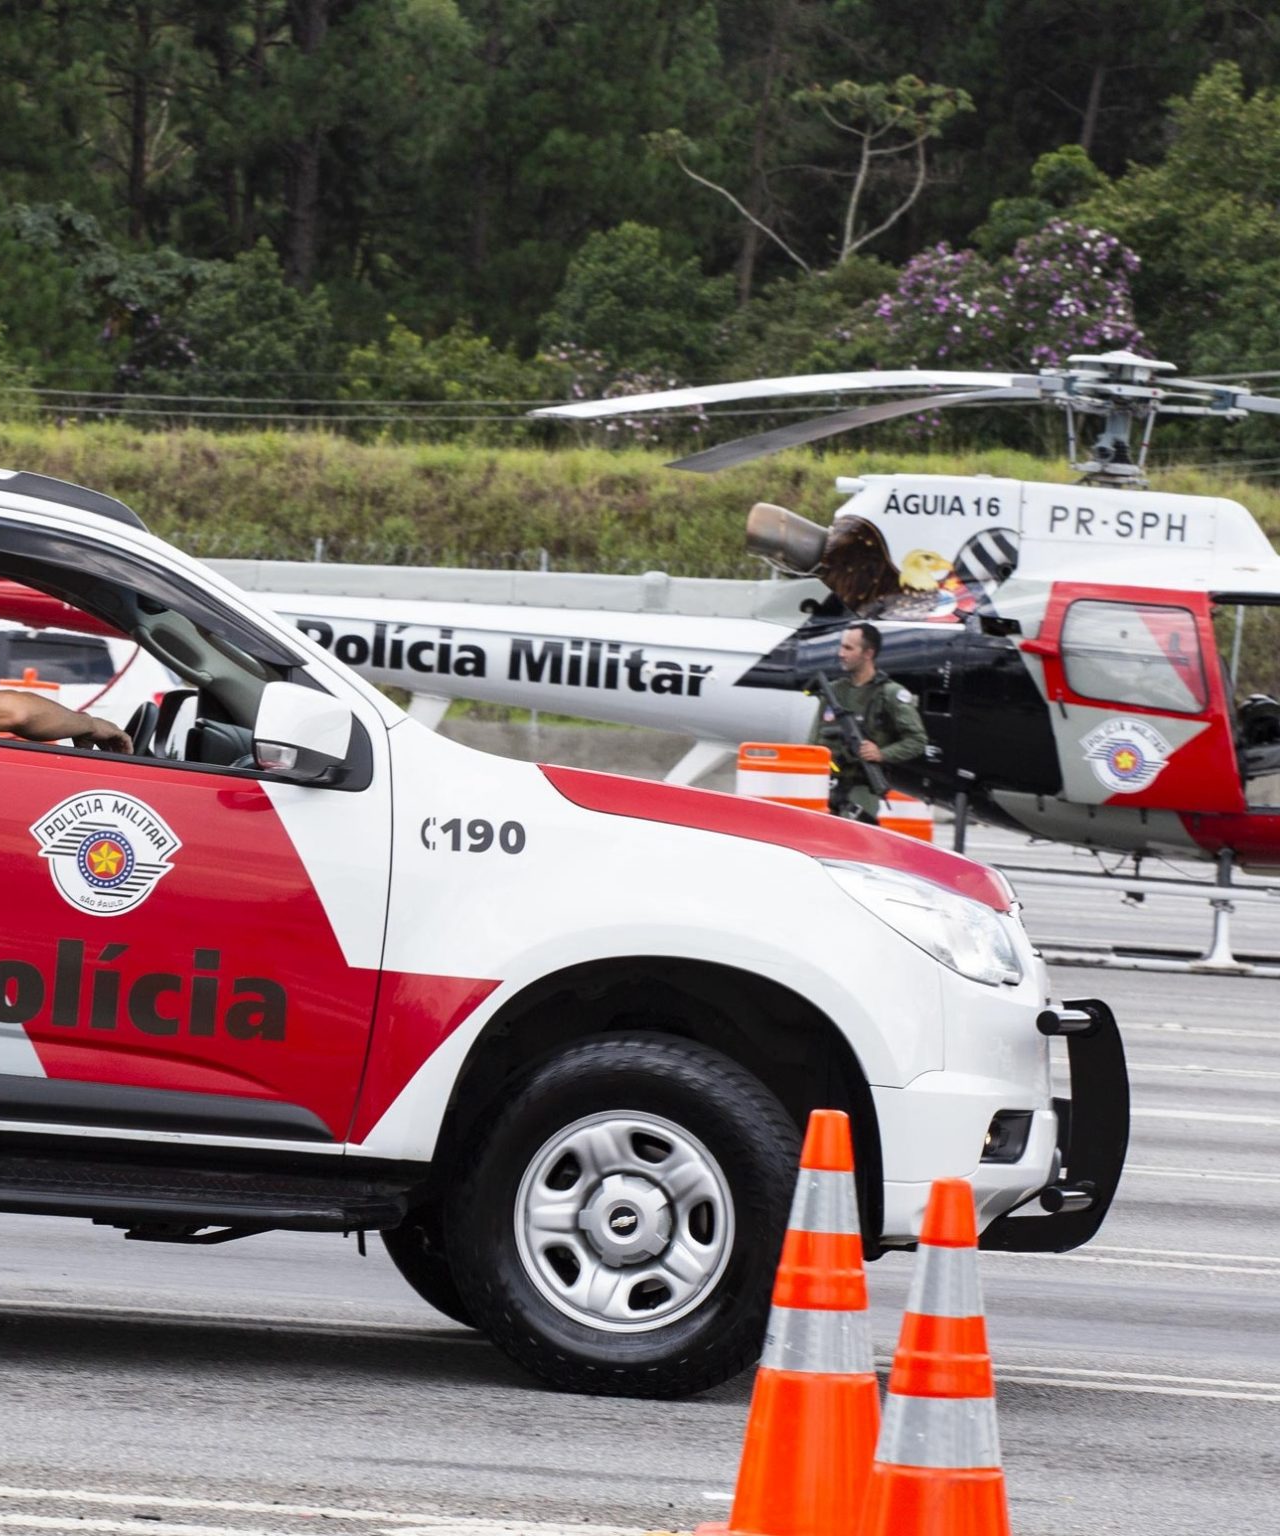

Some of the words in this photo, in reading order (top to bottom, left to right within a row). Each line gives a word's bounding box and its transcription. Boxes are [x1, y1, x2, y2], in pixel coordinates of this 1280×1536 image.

[884, 488, 965, 516] ÁGUIA
[973, 497, 1000, 517] 16
[1049, 505, 1187, 542] PR-SPH
[297, 619, 486, 678] Polícia
[508, 638, 712, 697] Militar
[44, 798, 104, 839] POLICIA
[112, 800, 168, 850] MILITAR
[440, 818, 526, 855] 190
